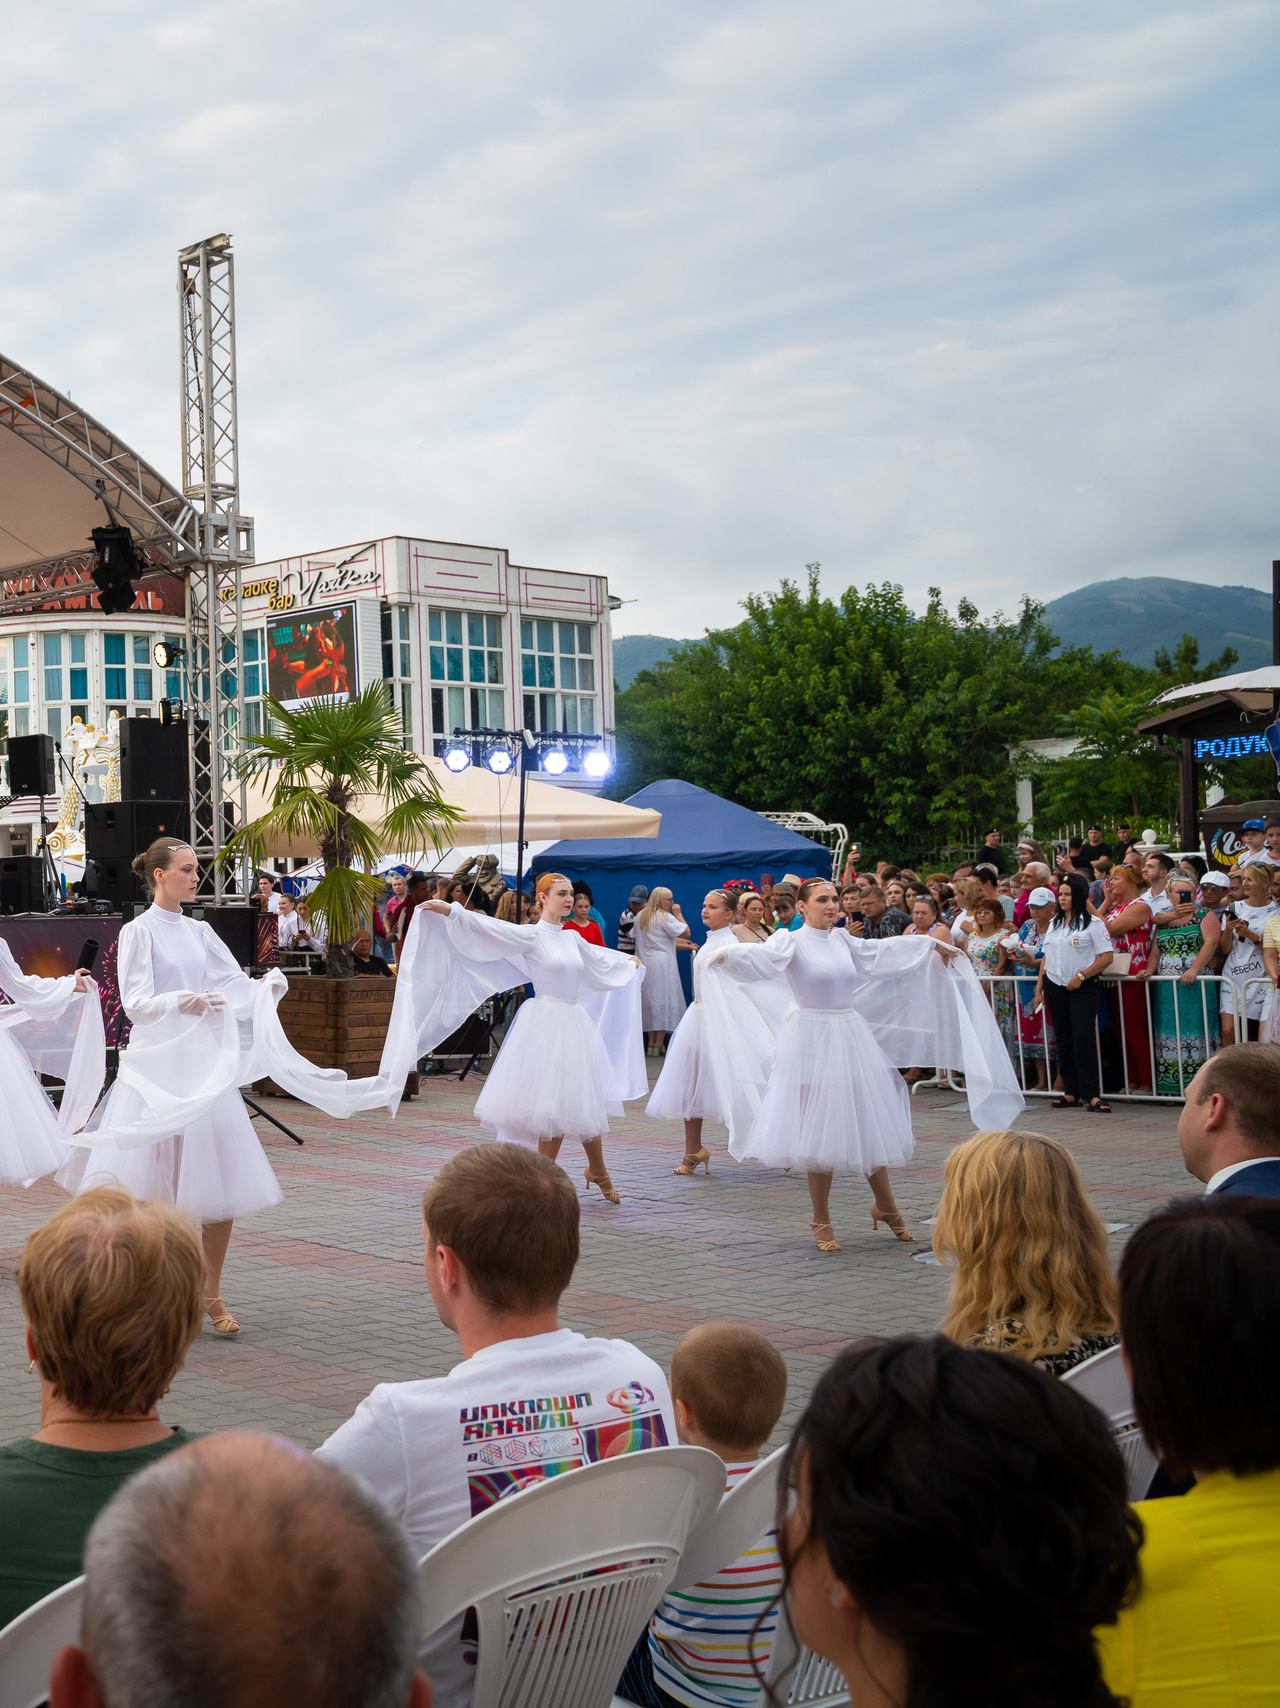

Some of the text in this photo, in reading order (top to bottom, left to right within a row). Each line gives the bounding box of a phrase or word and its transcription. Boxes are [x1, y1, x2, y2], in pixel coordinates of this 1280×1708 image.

[221, 579, 278, 601] кааоке
[281, 566, 381, 605] Чайка
[268, 593, 294, 610] бар
[1194, 735, 1269, 758] РОДУК
[460, 1392, 593, 1423] UNKNOWN
[463, 1412, 579, 1441] ARRIVAL
